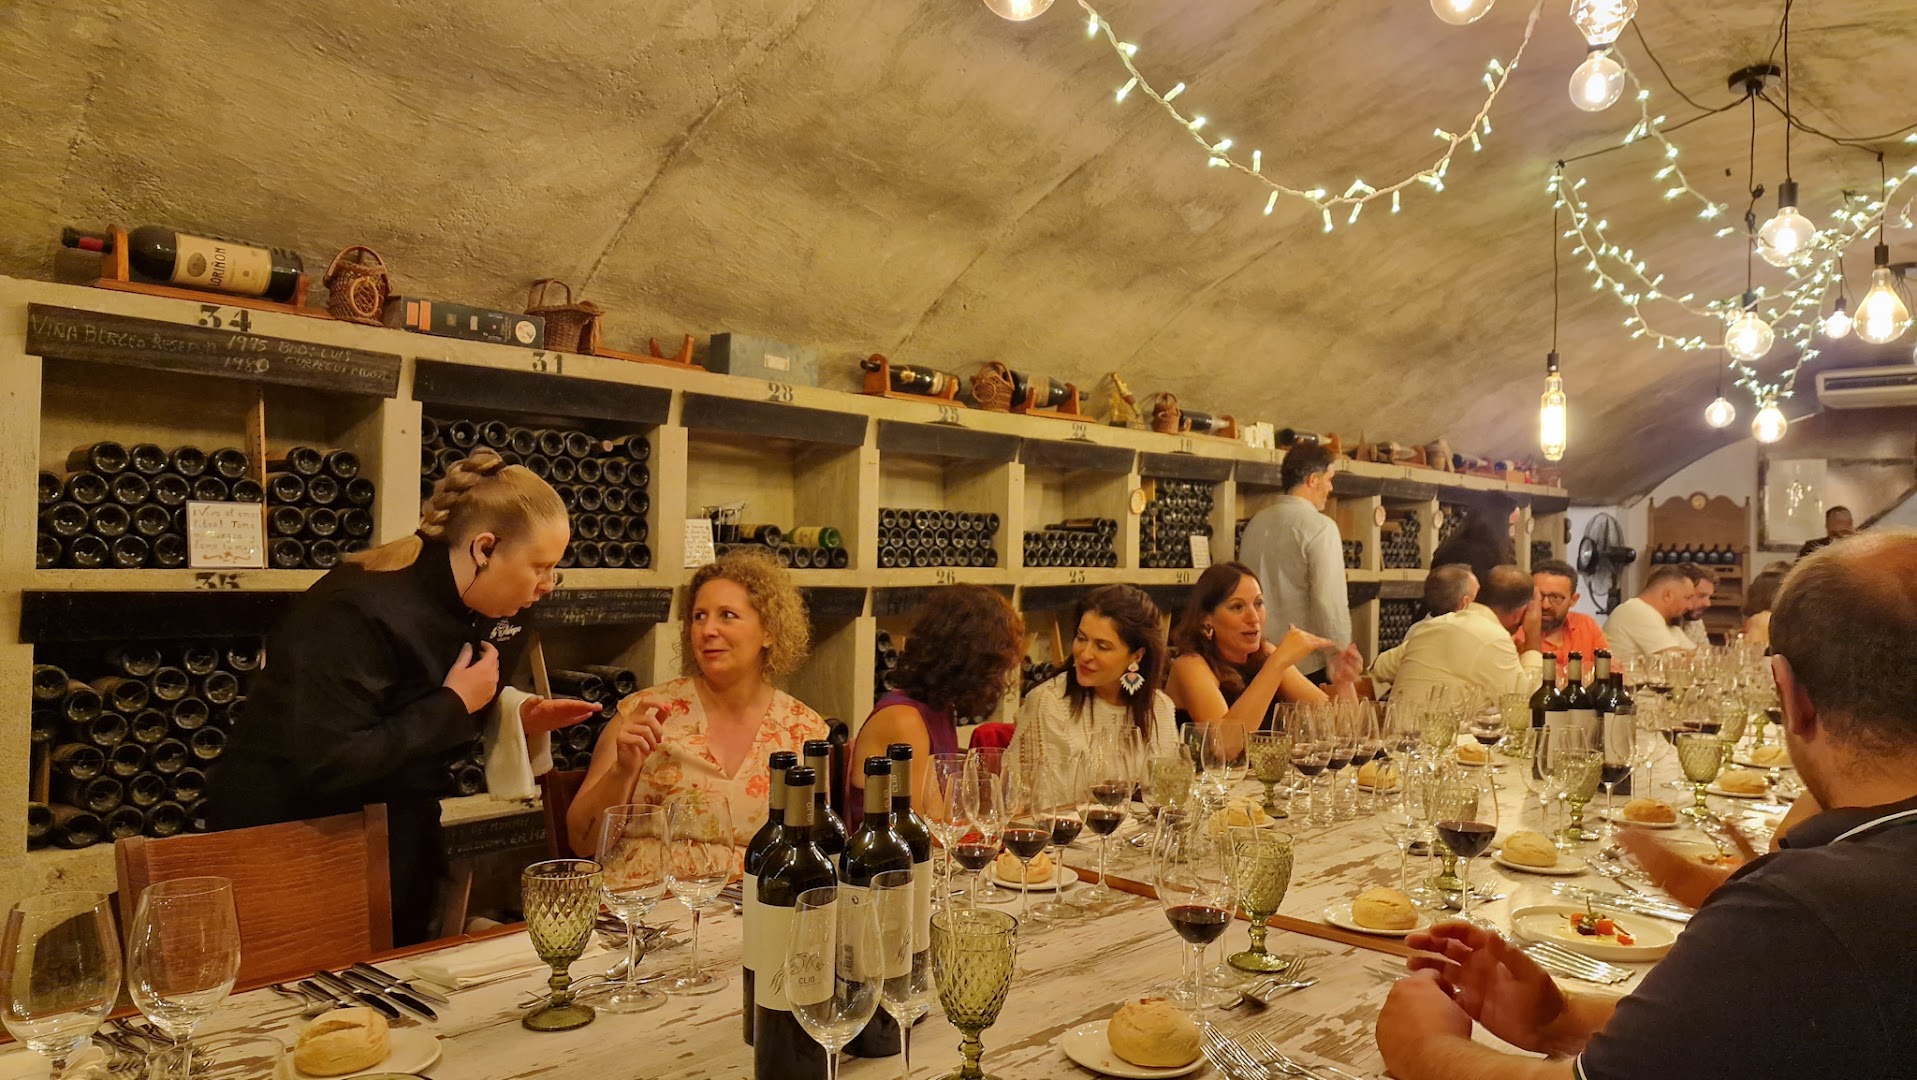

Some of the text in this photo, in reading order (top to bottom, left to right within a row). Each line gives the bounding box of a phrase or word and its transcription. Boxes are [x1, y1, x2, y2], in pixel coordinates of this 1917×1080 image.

[198, 304, 252, 332] 34
[227, 335, 268, 352] 1975
[532, 350, 563, 374] 31
[769, 382, 793, 403] 28
[1072, 422, 1087, 439] 22
[195, 572, 244, 589] 35
[936, 569, 955, 584] 26
[1069, 570, 1085, 584] 23
[1176, 570, 1190, 584] 20
[798, 975, 815, 985] CLIO
